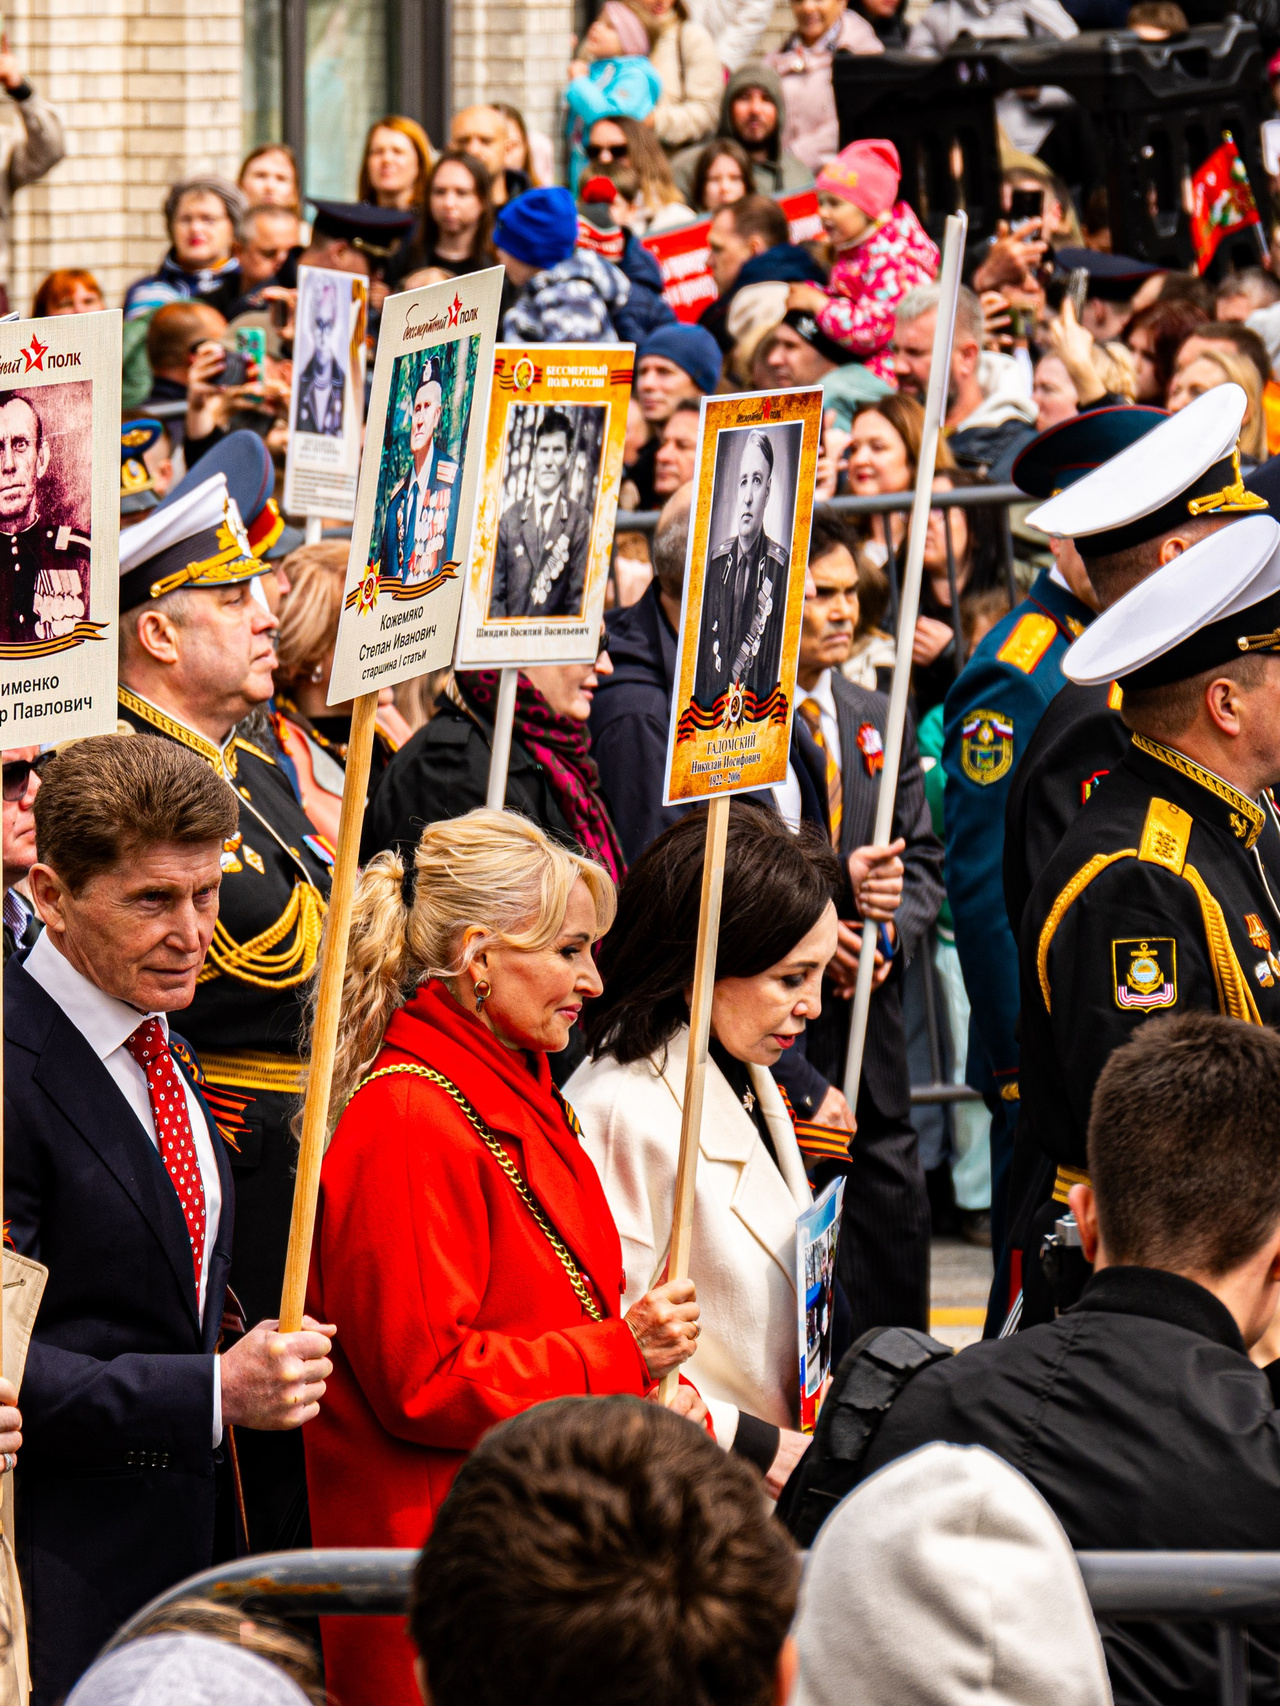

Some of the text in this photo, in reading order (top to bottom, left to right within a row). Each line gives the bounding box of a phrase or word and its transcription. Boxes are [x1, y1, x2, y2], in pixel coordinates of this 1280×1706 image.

[546, 364, 608, 377] БЕССМЕРТНЫЙ
[547, 377, 605, 388] ПОЛК РОССИИ
[380, 606, 424, 632] Кожемяко
[359, 624, 437, 662] Степан Иванович
[476, 626, 590, 638] Шиндин Василий Васильевич
[362, 659, 397, 680] старшина
[402, 649, 427, 667] статьи
[13, 696, 92, 721] Павлович
[706, 731, 756, 755] ГАДОМСКИЙ
[691, 753, 761, 774] Николай Иосифович
[709, 774, 723, 787] 1922
